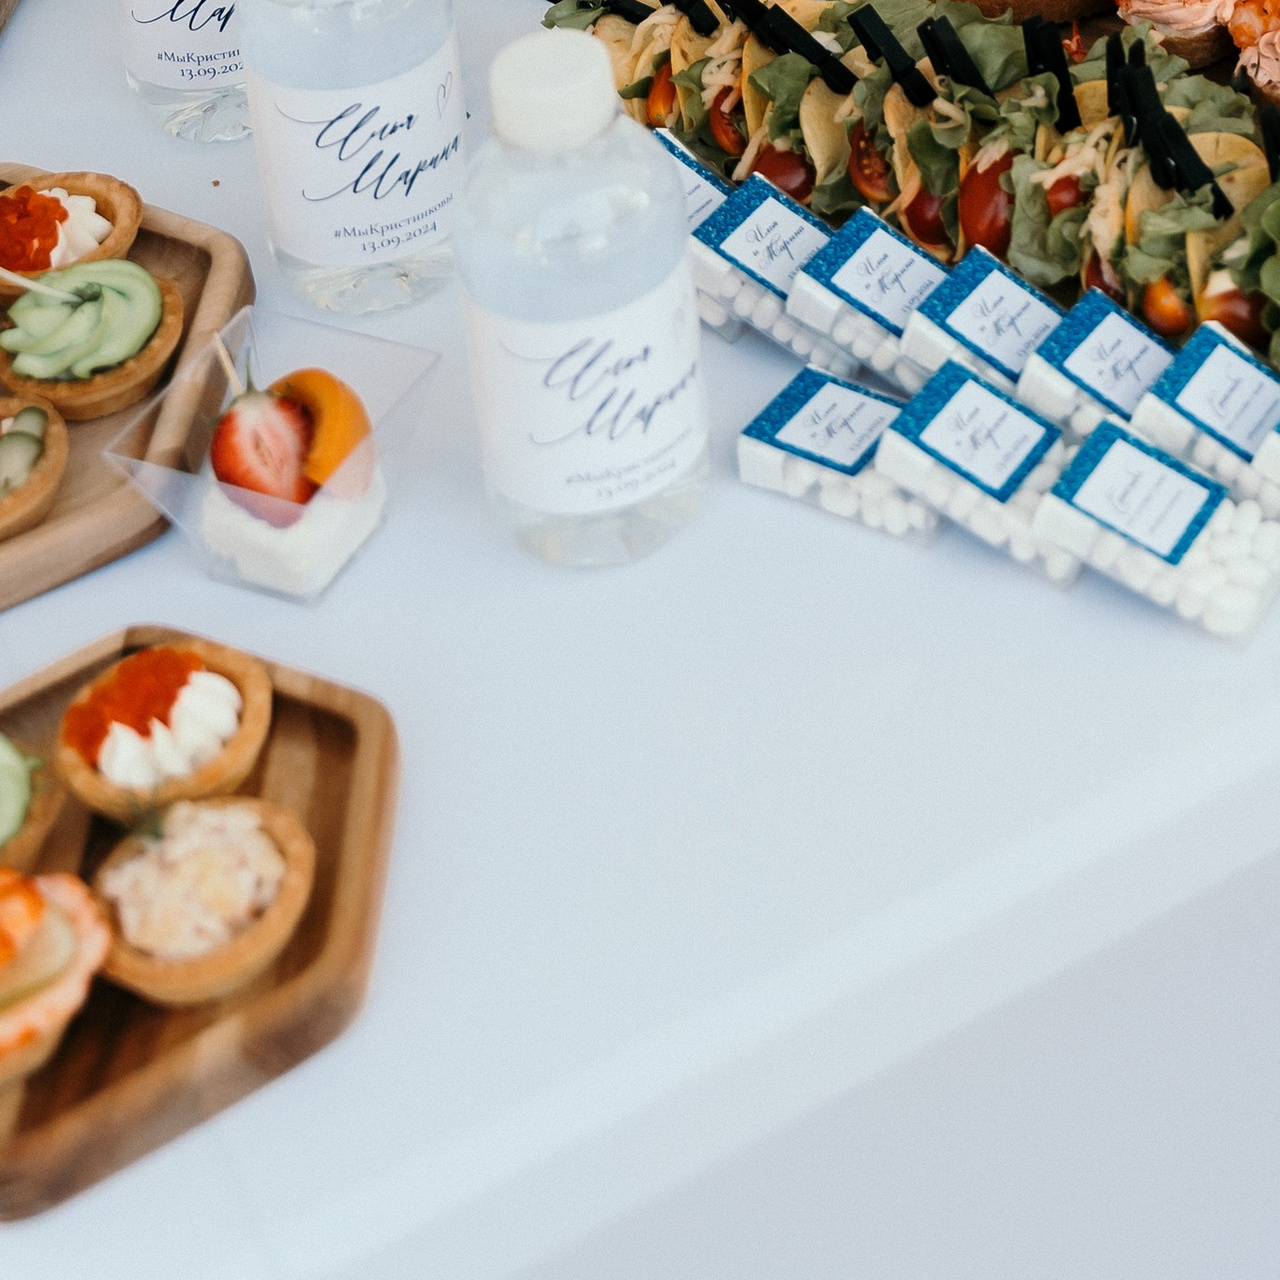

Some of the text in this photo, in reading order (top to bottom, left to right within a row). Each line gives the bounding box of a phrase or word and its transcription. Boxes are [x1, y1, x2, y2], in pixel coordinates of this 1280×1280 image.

[157, 48, 241, 66] #МыКристи
[334, 192, 453, 238] #МыКристинковы
[361, 220, 437, 253] 13.09.2024
